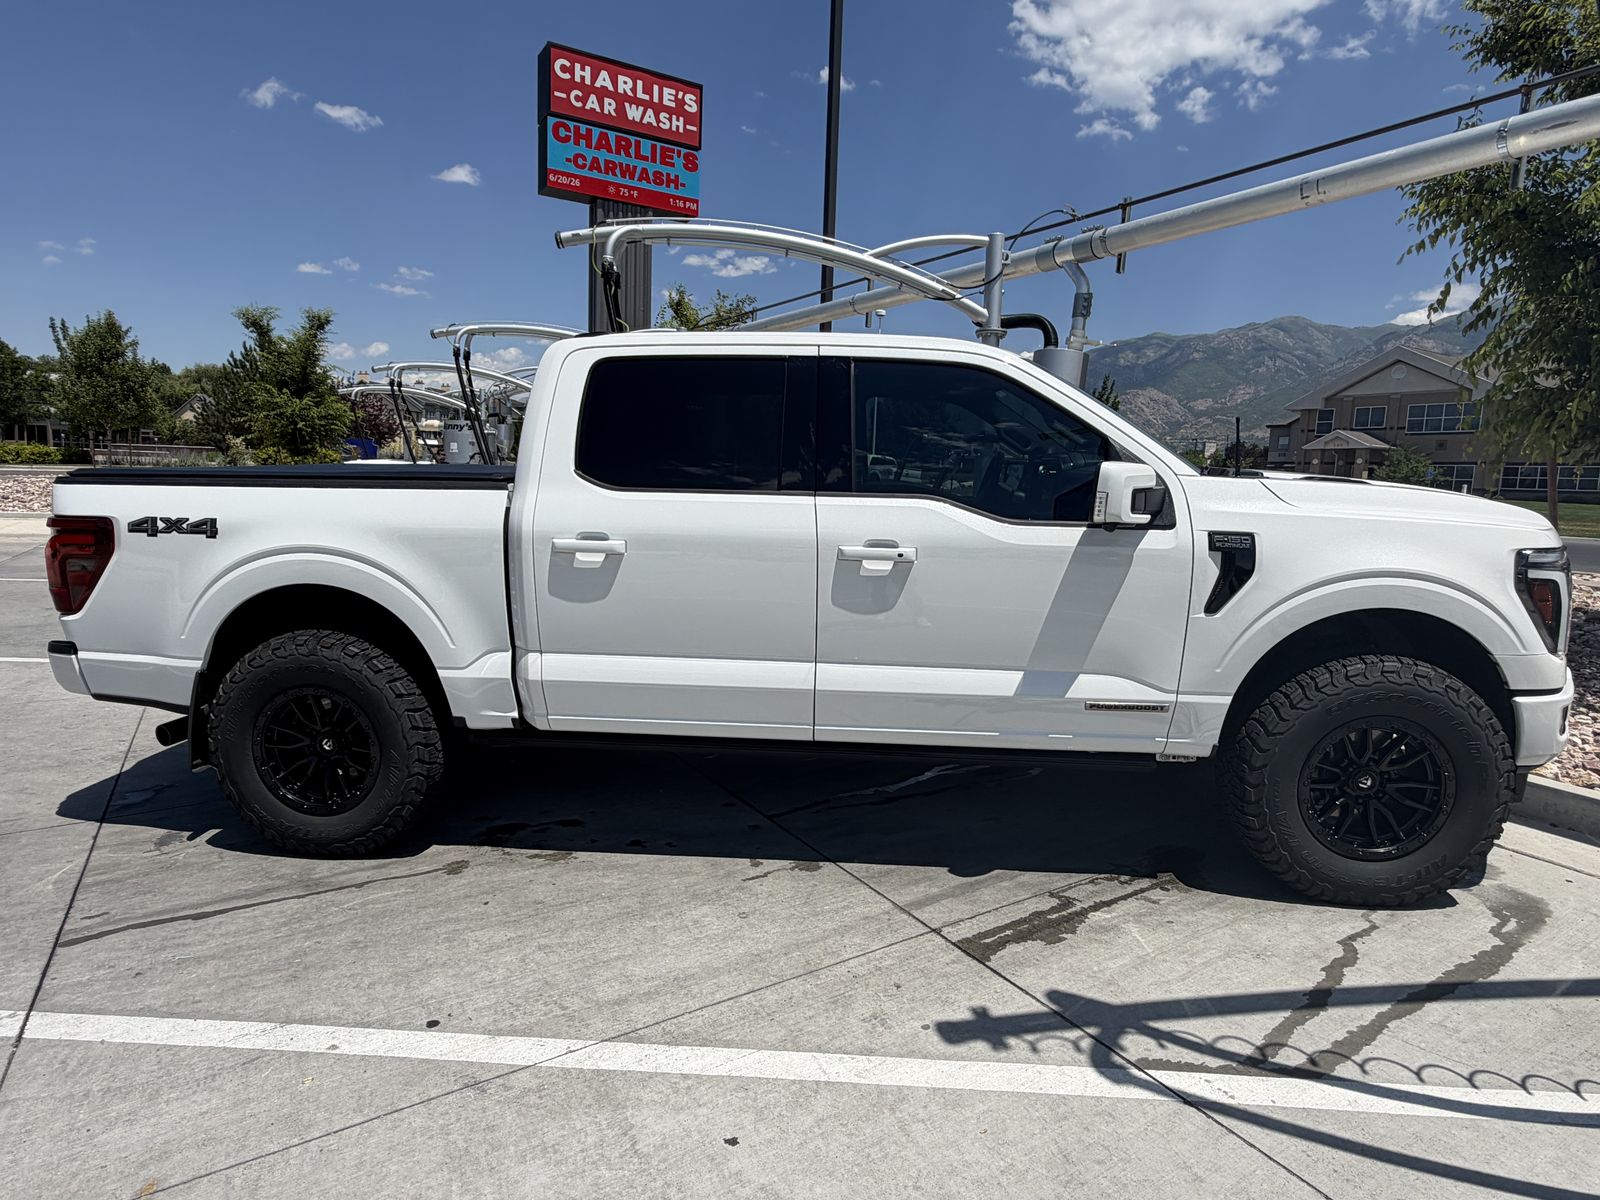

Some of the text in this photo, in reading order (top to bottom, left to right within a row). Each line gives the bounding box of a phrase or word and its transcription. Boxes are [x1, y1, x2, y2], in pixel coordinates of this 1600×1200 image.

[553, 58, 698, 113] CHARLIE'S
[551, 120, 700, 173] CHARLIE'S
[549, 173, 581, 188] 6/20/26
[619, 187, 630, 197] 75
[669, 198, 698, 211] 1:16 PM
